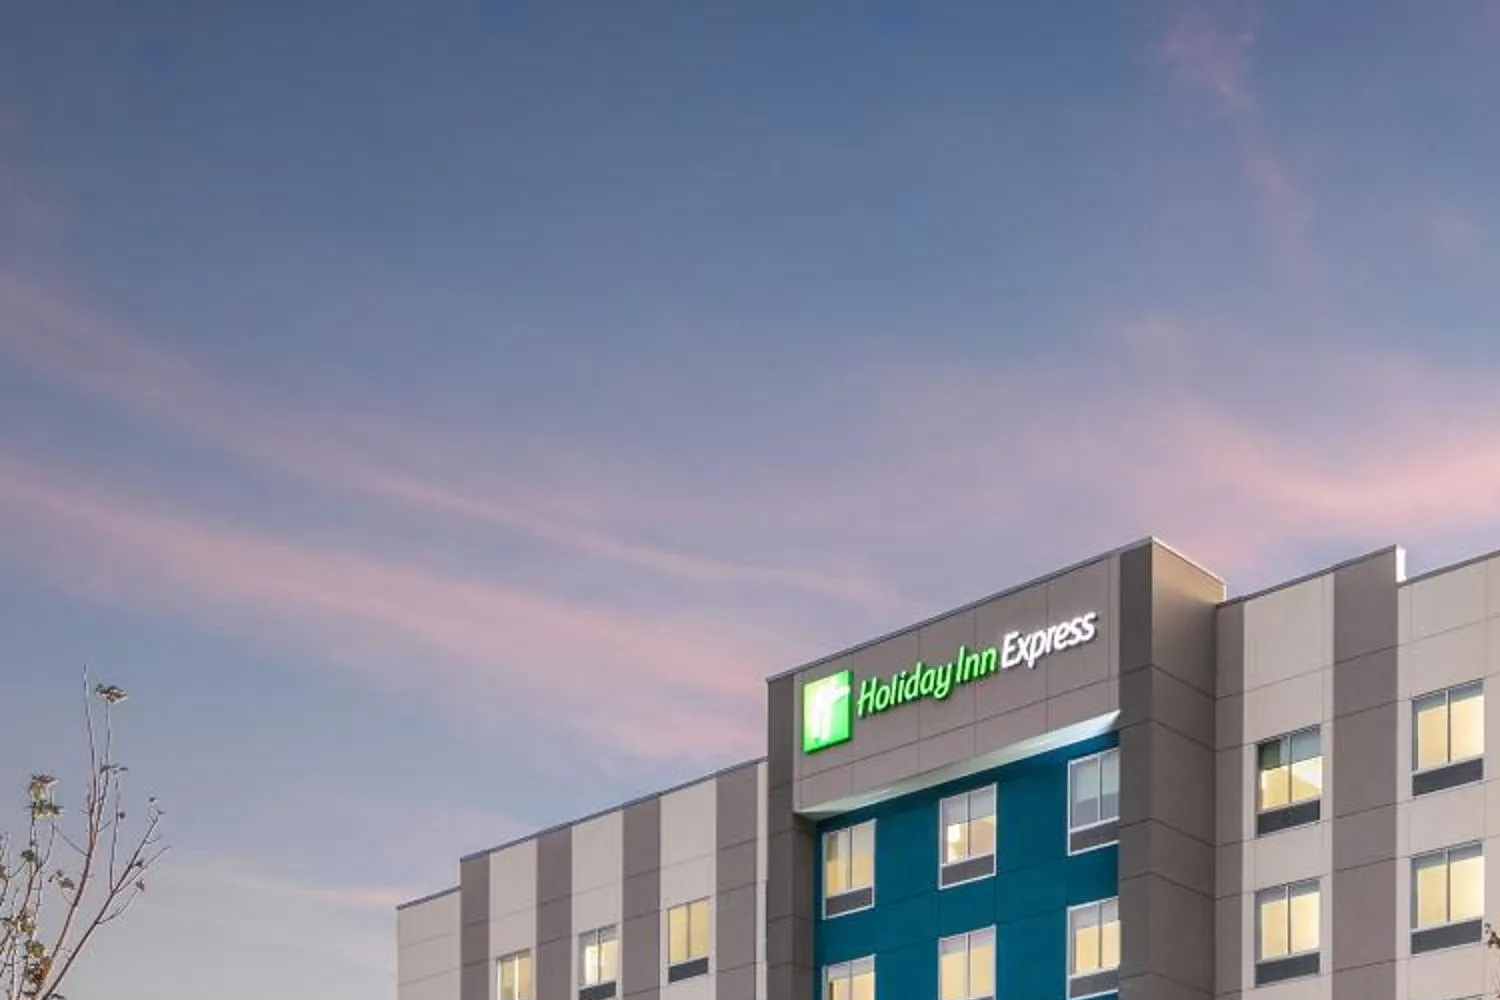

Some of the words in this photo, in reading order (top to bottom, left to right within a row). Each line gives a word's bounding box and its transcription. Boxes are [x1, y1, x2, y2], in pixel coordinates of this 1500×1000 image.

[857, 662, 954, 717] Holiday
[955, 645, 997, 683] Inn
[1001, 611, 1097, 669] Express
